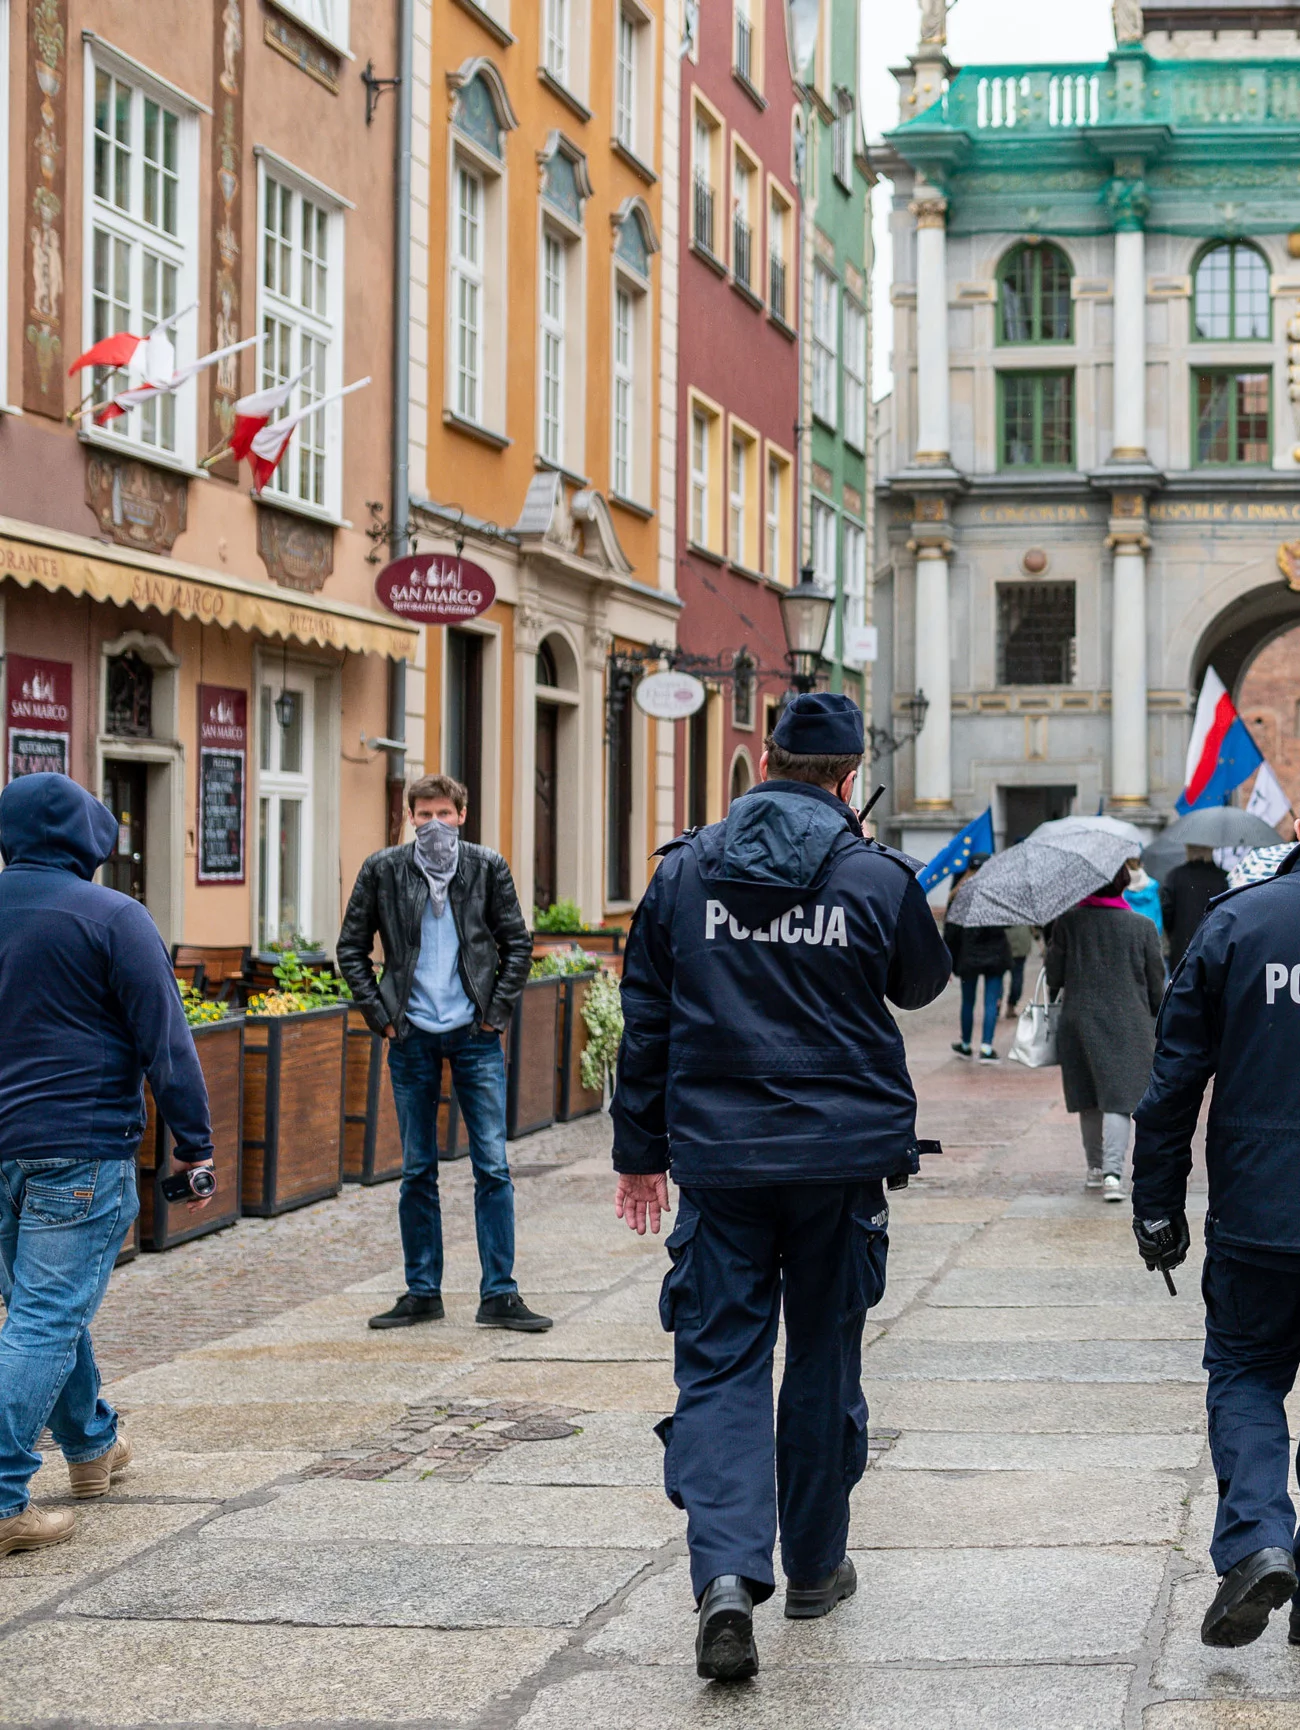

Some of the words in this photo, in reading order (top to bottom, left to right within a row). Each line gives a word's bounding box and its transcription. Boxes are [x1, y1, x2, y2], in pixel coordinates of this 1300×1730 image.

[132, 574, 165, 605] SAN
[171, 583, 225, 616] MARCO
[389, 584, 421, 602] SAN
[424, 587, 482, 606] MARCO
[11, 700, 31, 718] SAN
[32, 703, 68, 721] MARCO
[202, 722, 217, 739] SAN
